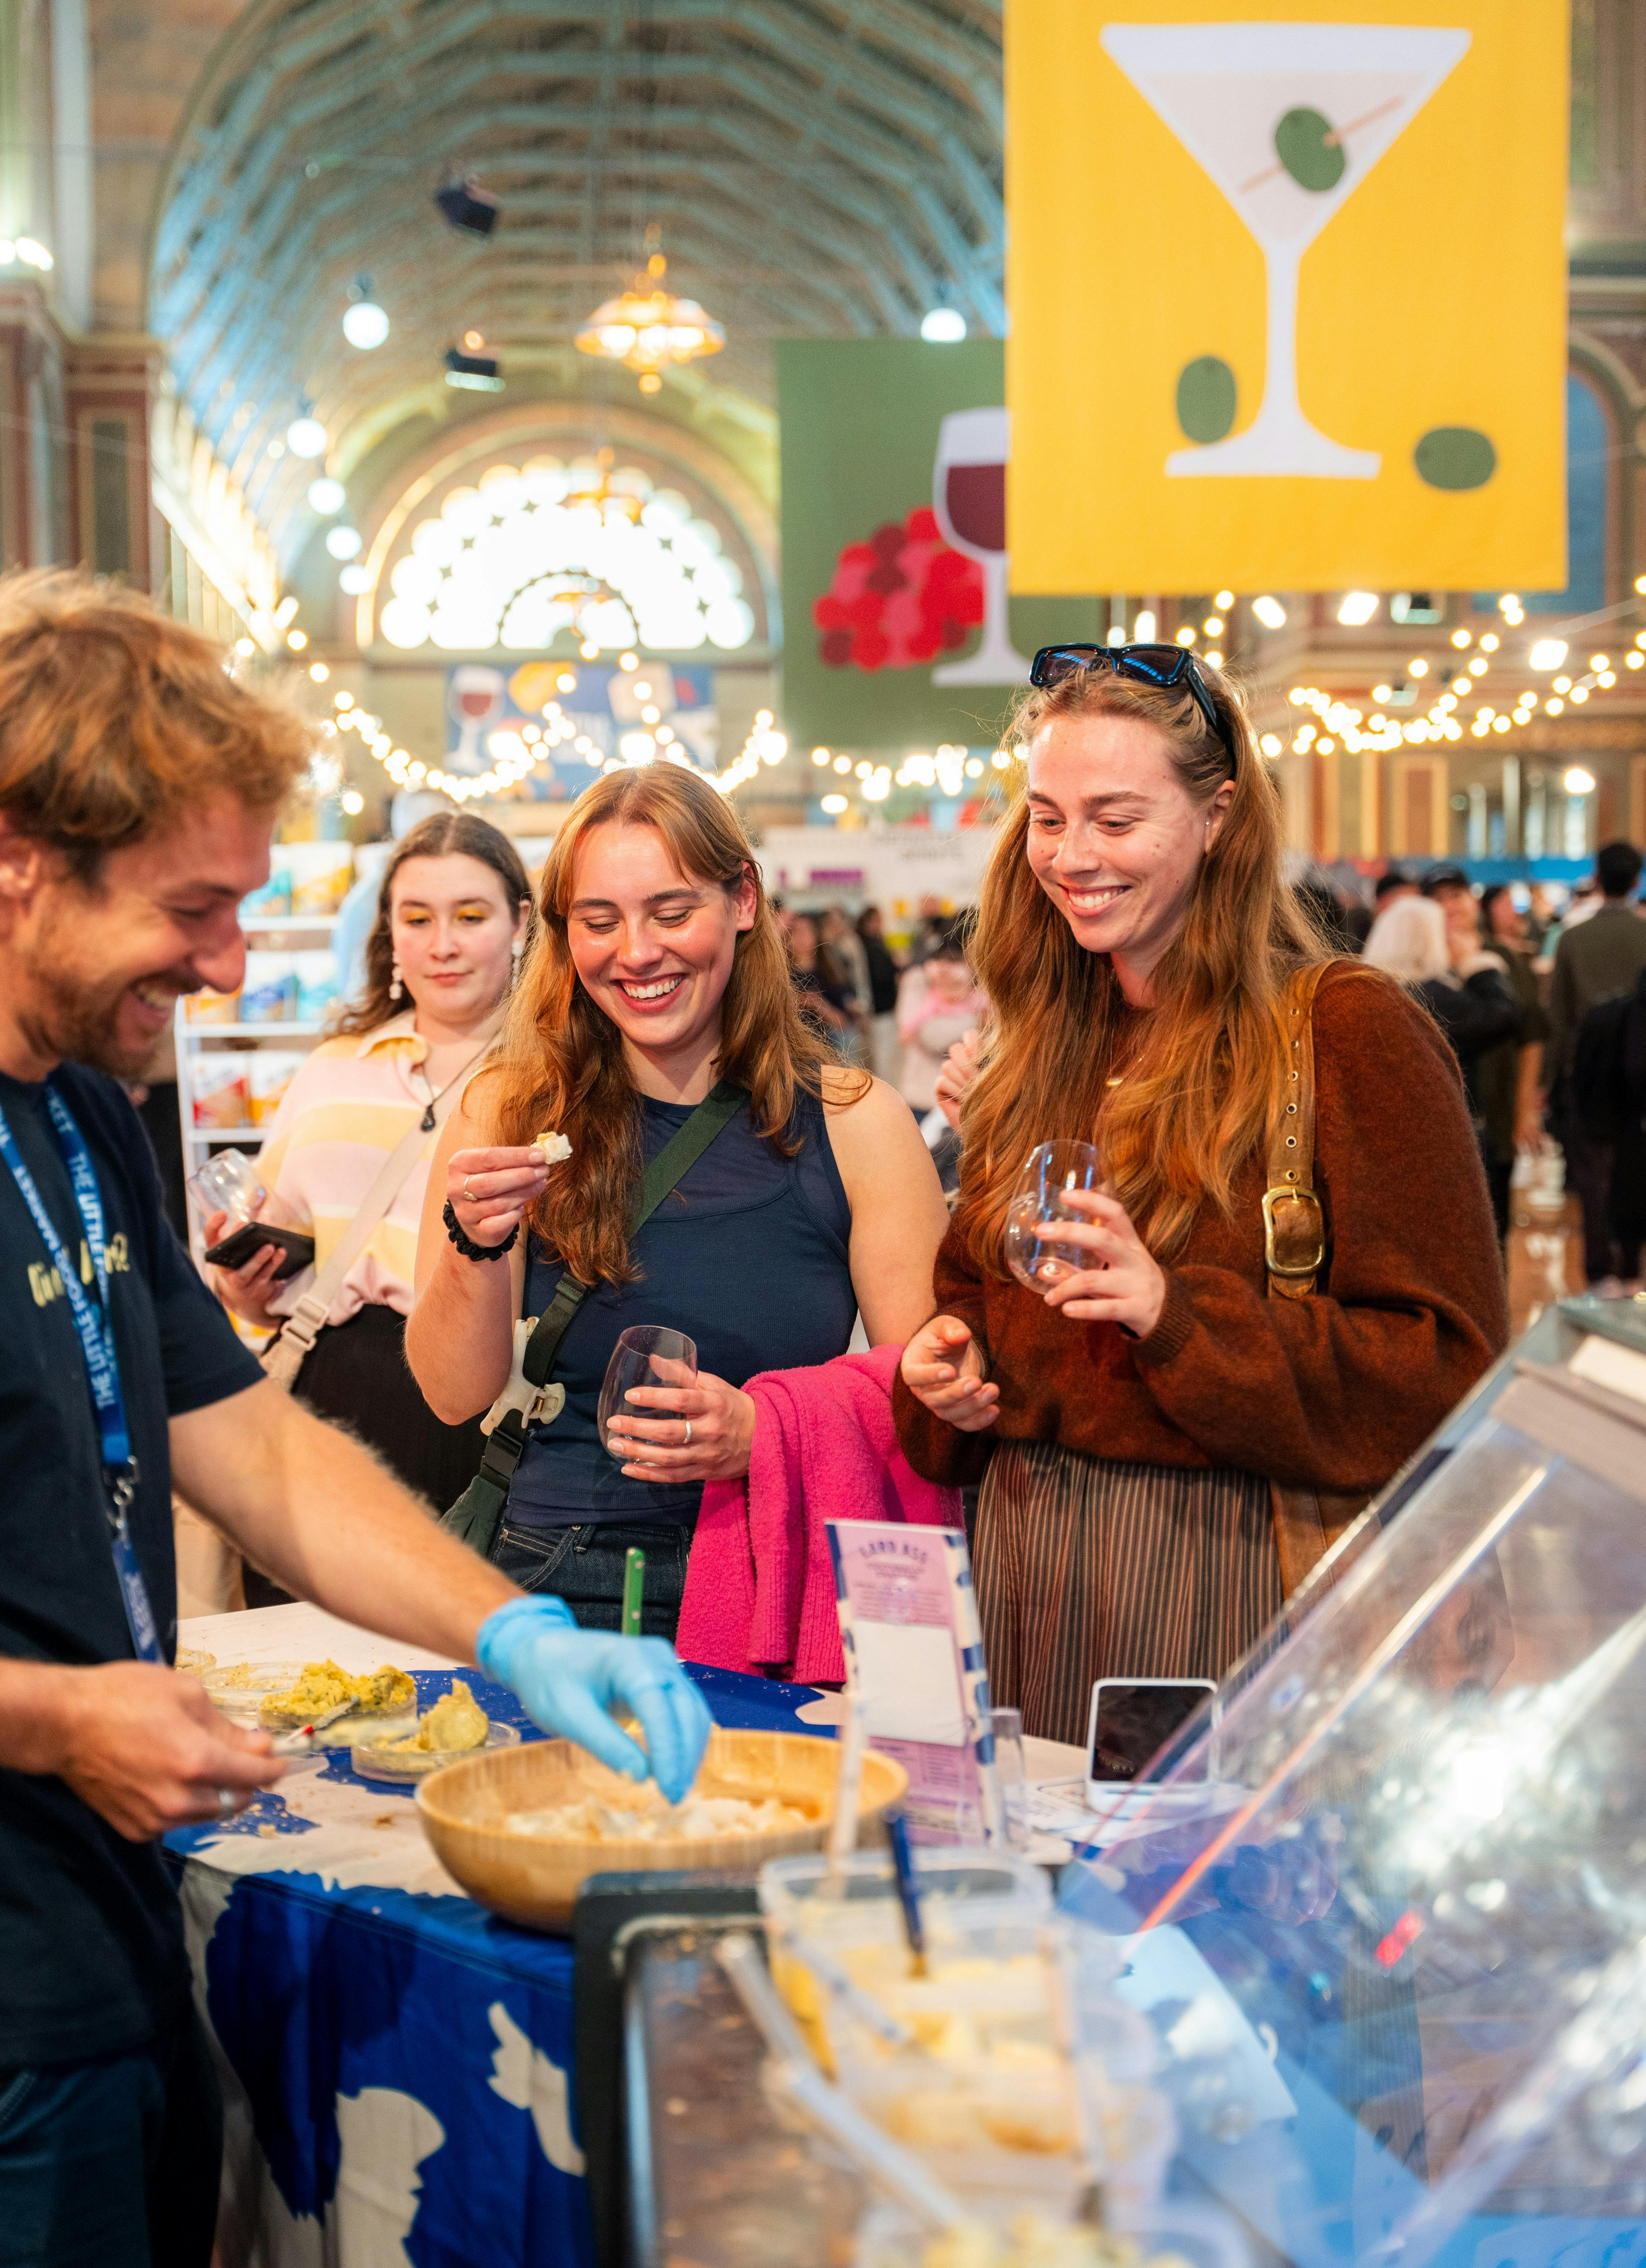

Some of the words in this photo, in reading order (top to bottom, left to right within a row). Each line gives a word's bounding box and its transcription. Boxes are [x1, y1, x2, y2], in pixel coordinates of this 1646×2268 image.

[68, 1152, 96, 1189] THE
[12, 1164, 61, 1251] MARKET
[78, 1193, 105, 1254] LITTLE
[54, 1250, 89, 1312] FOOD
[76, 1310, 107, 1372] LITTLE
[90, 1370, 115, 1411] THE
